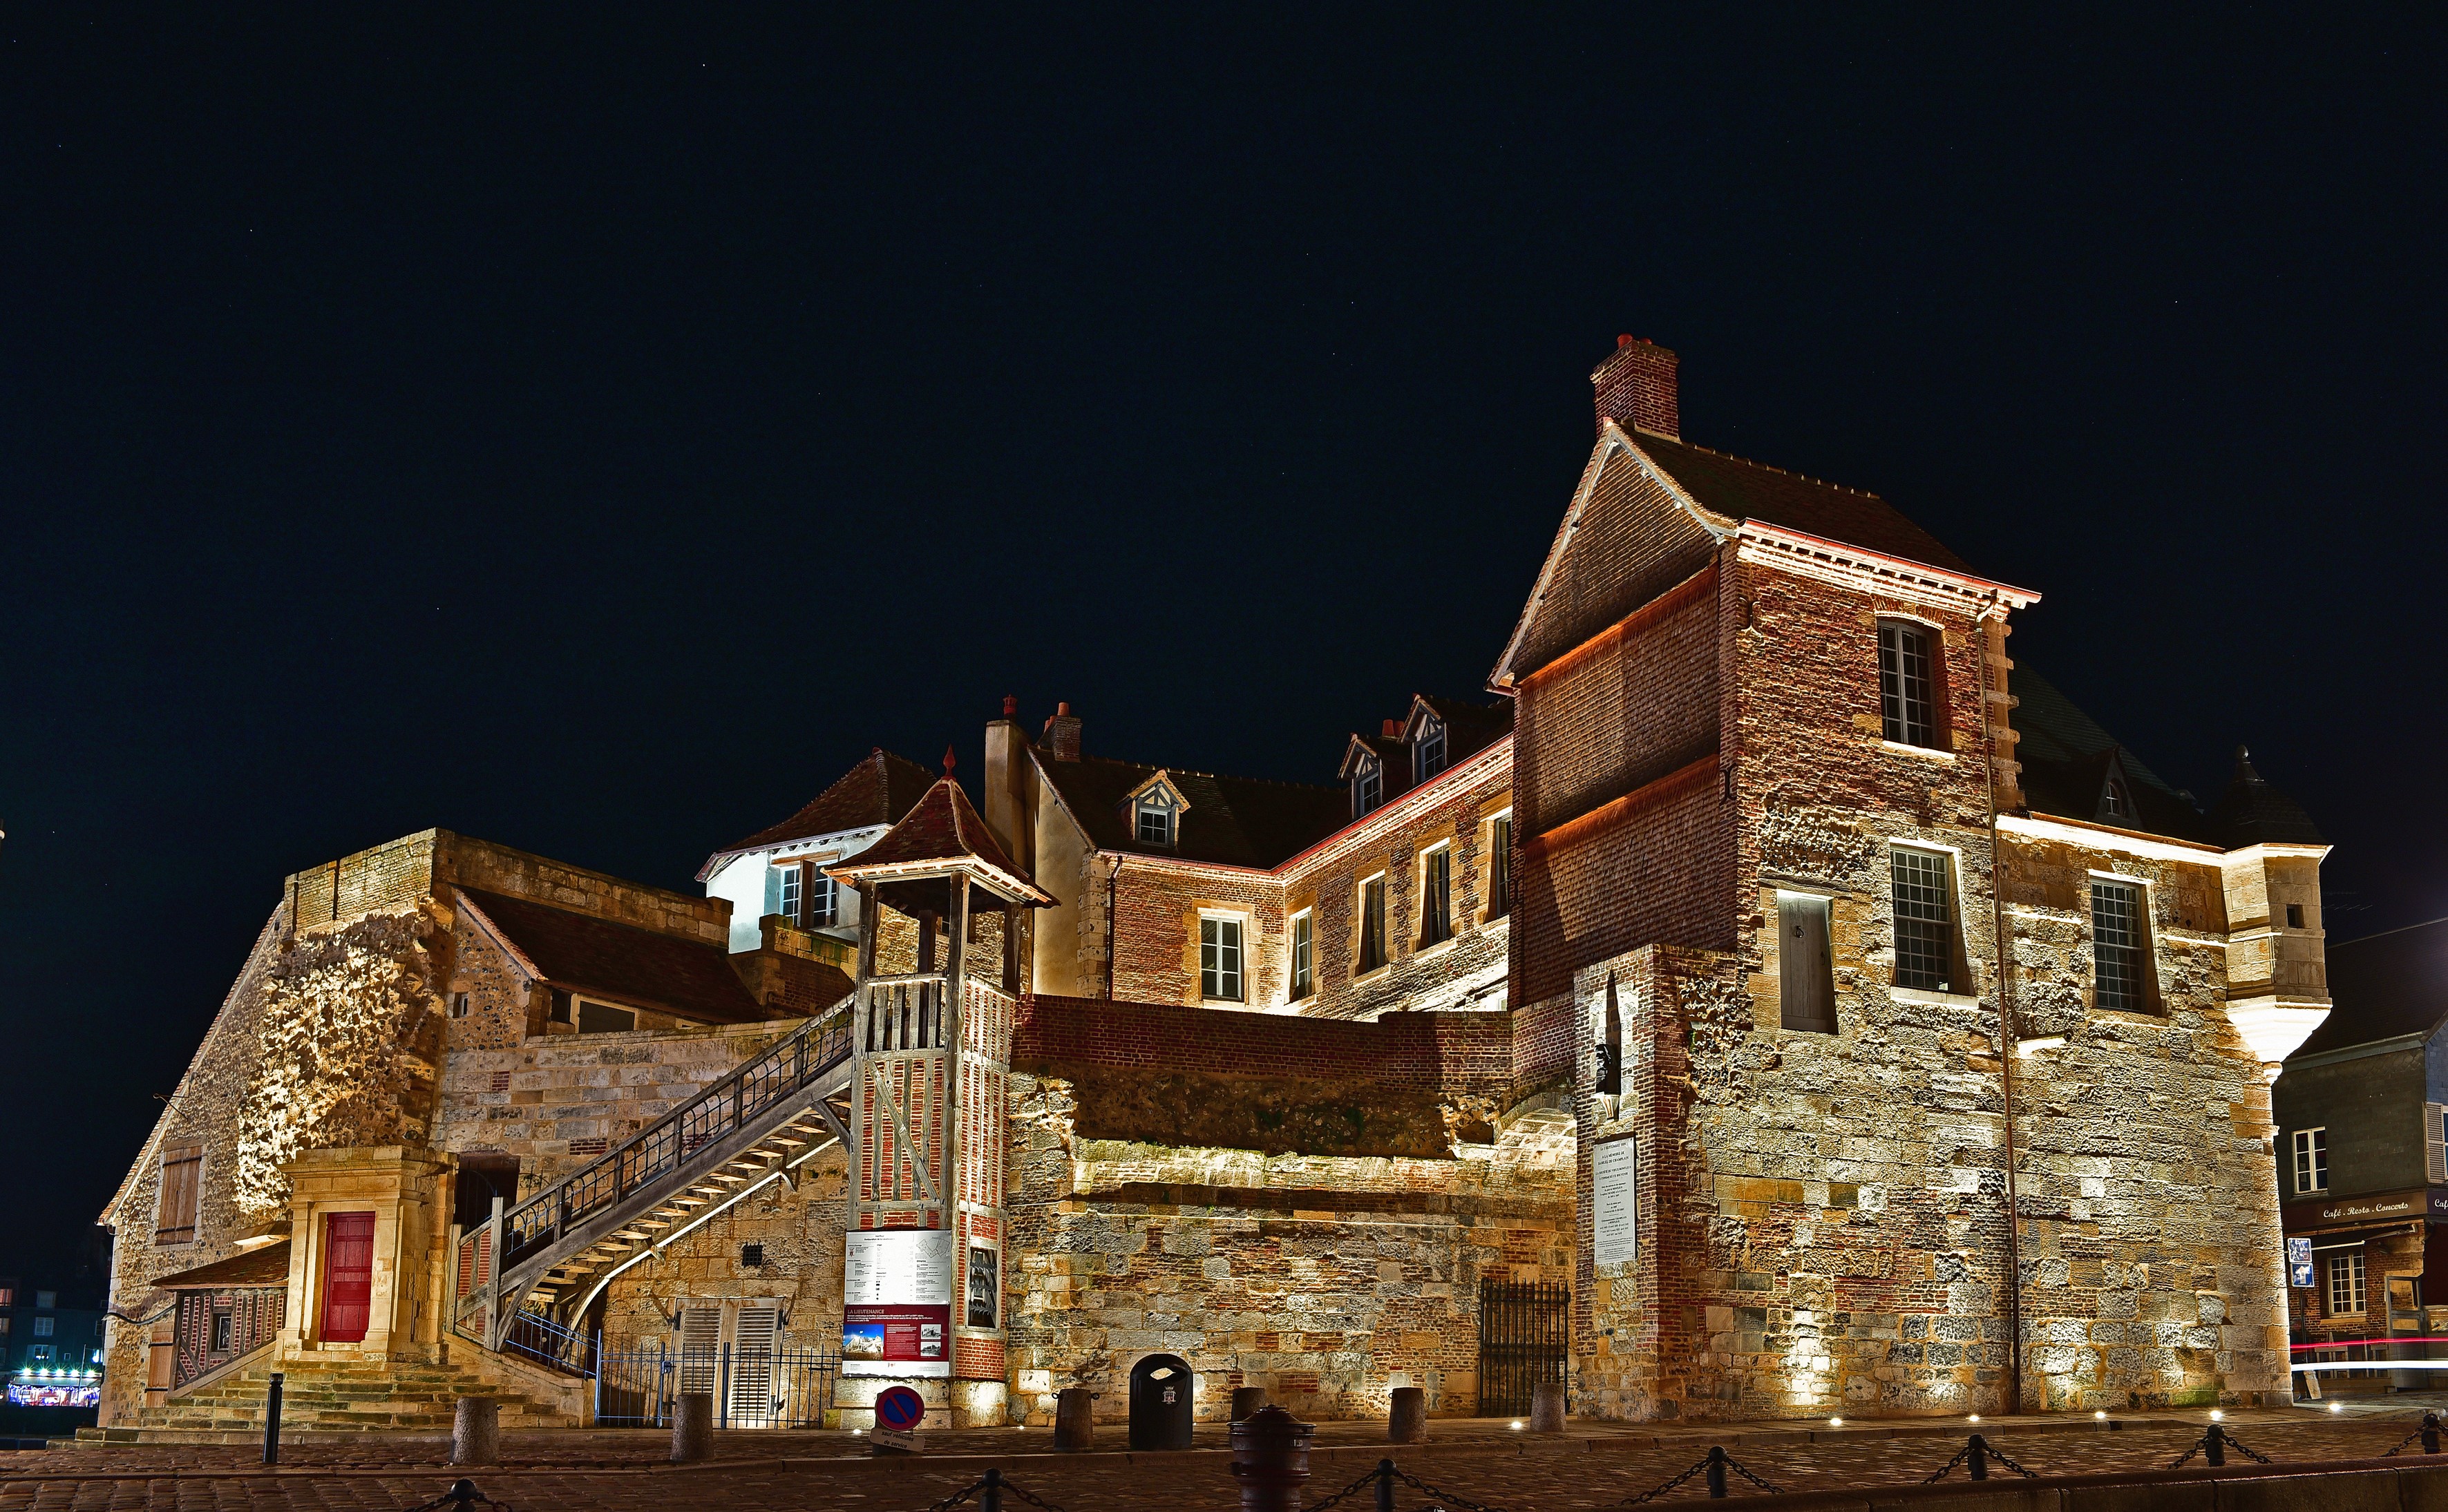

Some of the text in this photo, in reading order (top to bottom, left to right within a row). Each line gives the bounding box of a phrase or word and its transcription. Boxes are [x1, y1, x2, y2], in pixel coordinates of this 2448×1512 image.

[2434, 1198, 2448, 1209] Caf
[2323, 1208, 2342, 1219] Café
[2346, 1206, 2371, 1216] Resto
[2375, 1202, 2409, 1212] Concerts
[893, 1433, 914, 1442] véhicules
